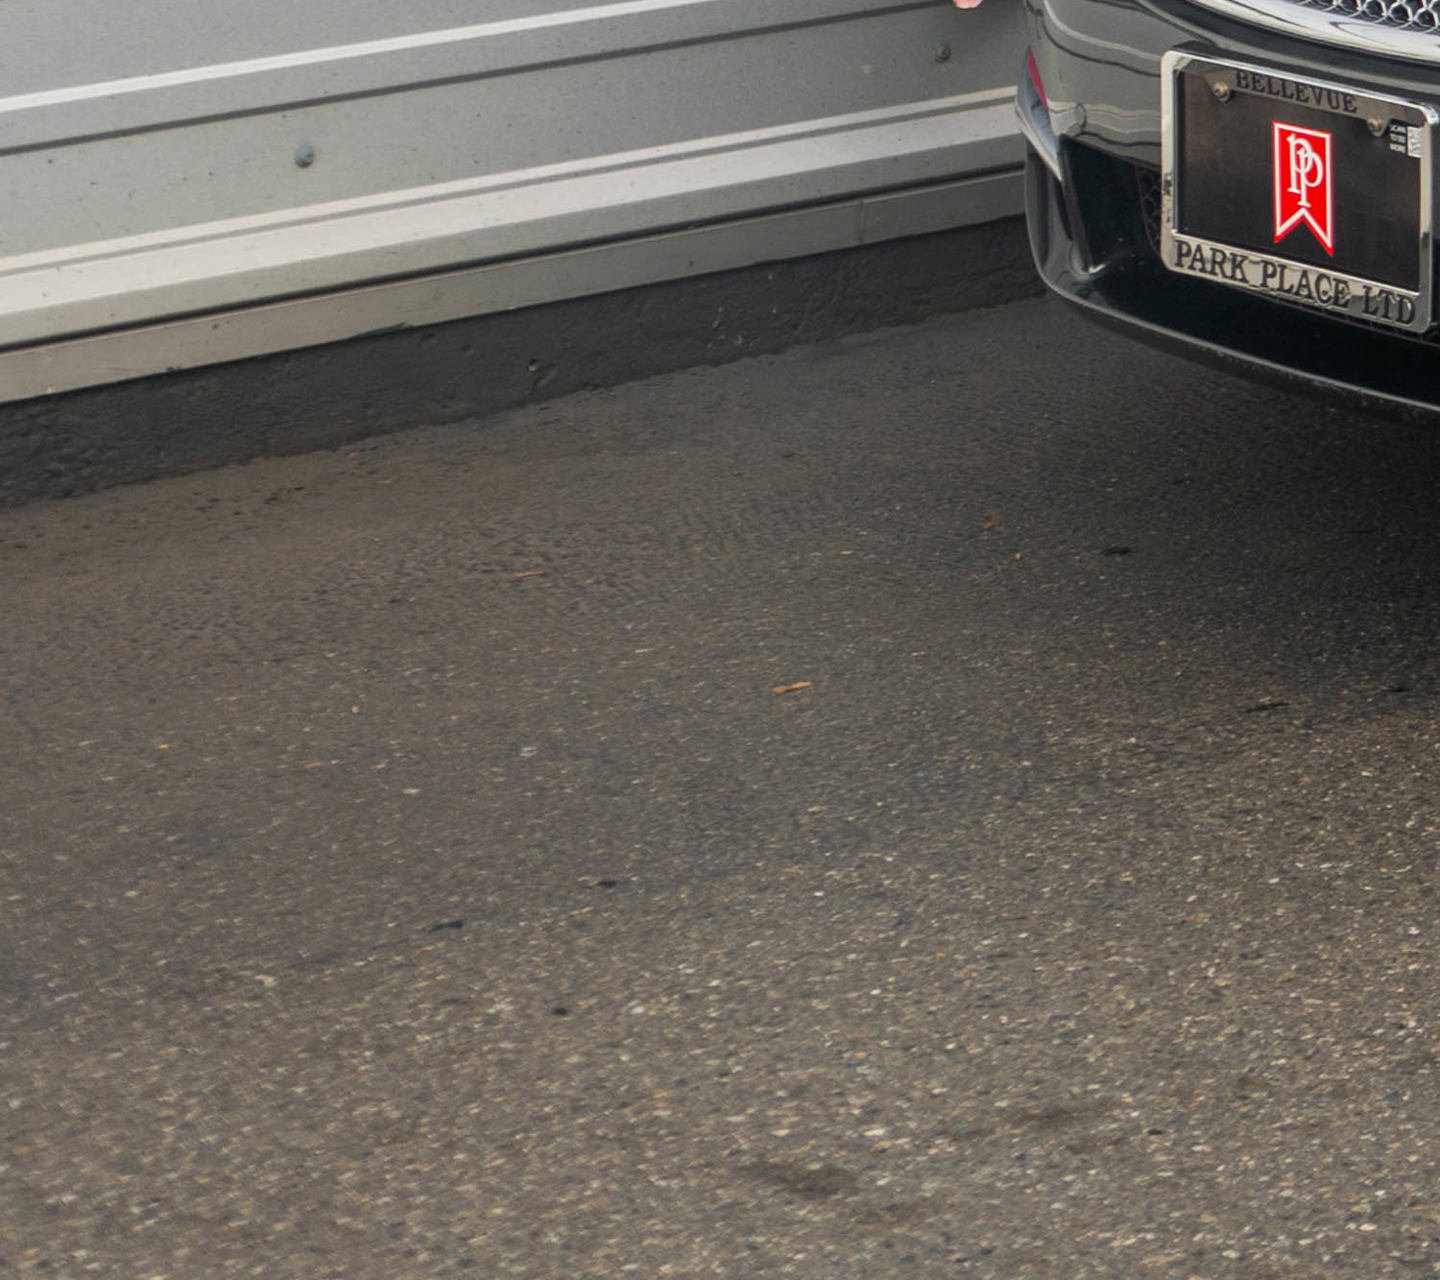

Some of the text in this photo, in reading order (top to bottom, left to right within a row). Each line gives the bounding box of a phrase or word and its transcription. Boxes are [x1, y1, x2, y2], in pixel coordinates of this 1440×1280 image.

[1235, 69, 1358, 113] BELLEVUE
[1174, 239, 1417, 325] PARK PLACE LTD
